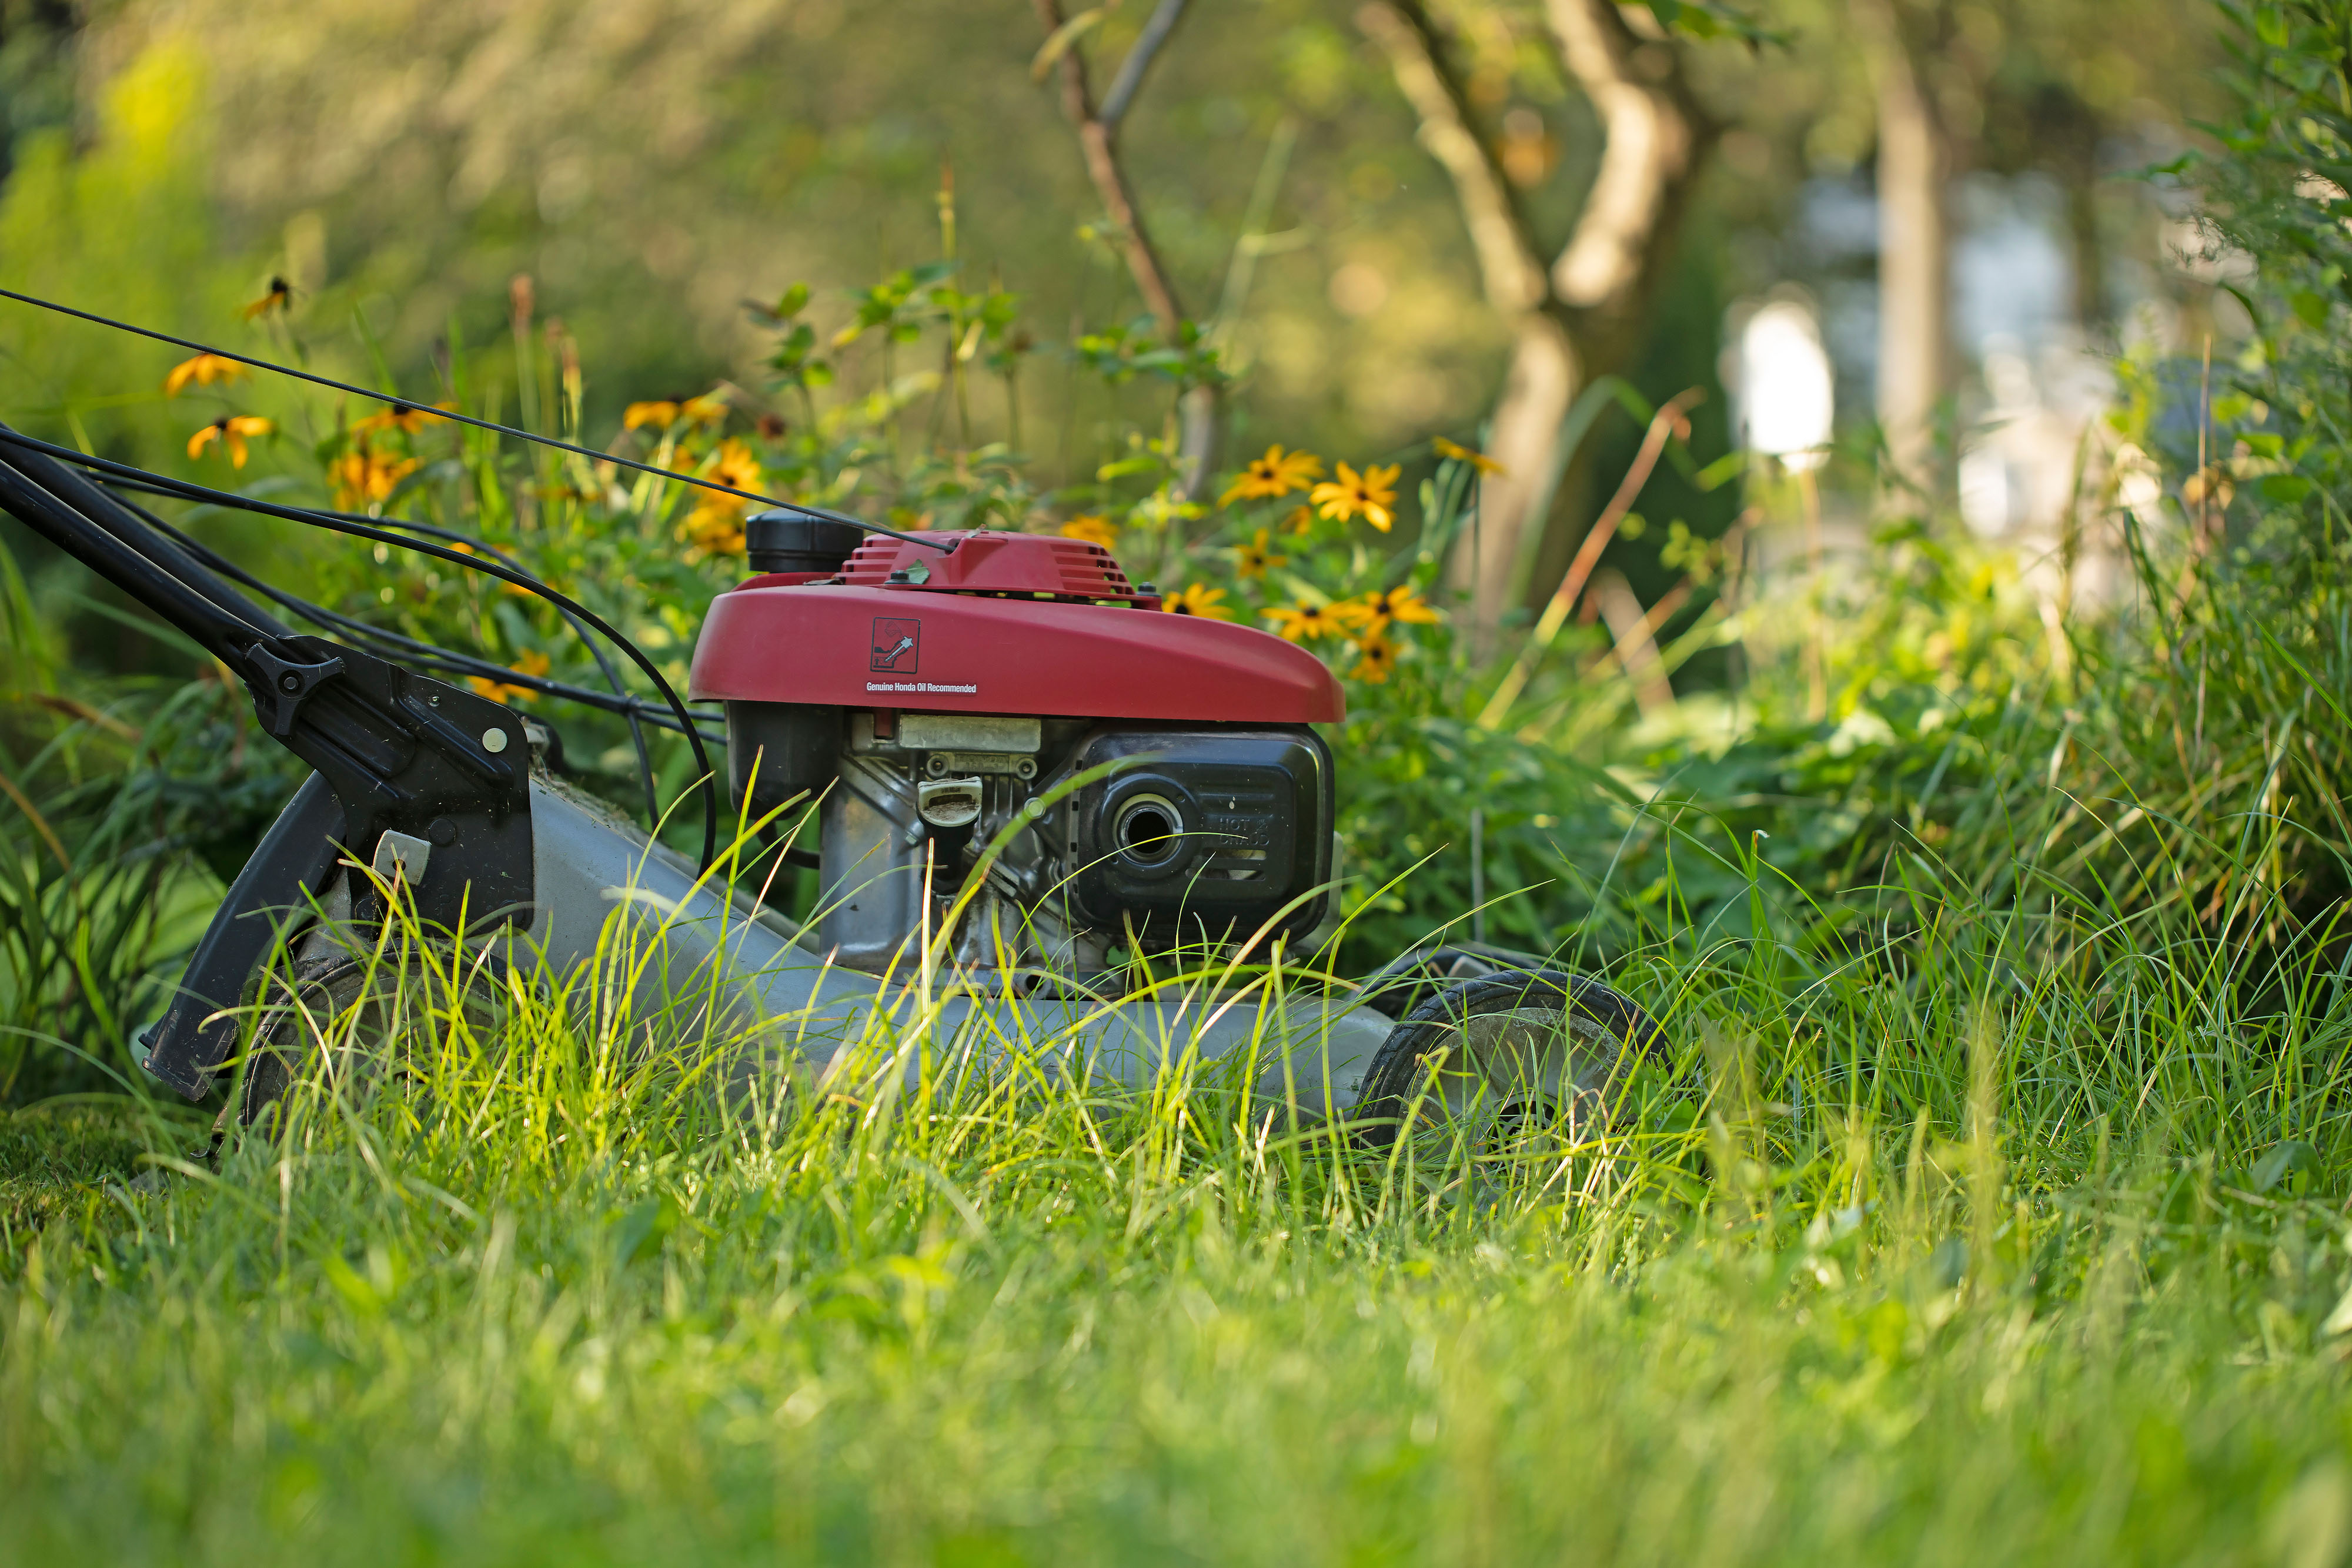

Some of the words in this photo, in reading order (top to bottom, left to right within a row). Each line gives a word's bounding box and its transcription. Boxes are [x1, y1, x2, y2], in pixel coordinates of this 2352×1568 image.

[867, 682, 893, 691] Genuine
[894, 683, 916, 691] Honda
[917, 683, 926, 691] Oil
[927, 683, 976, 693] Recommended
[1219, 818, 1250, 830] HOT
